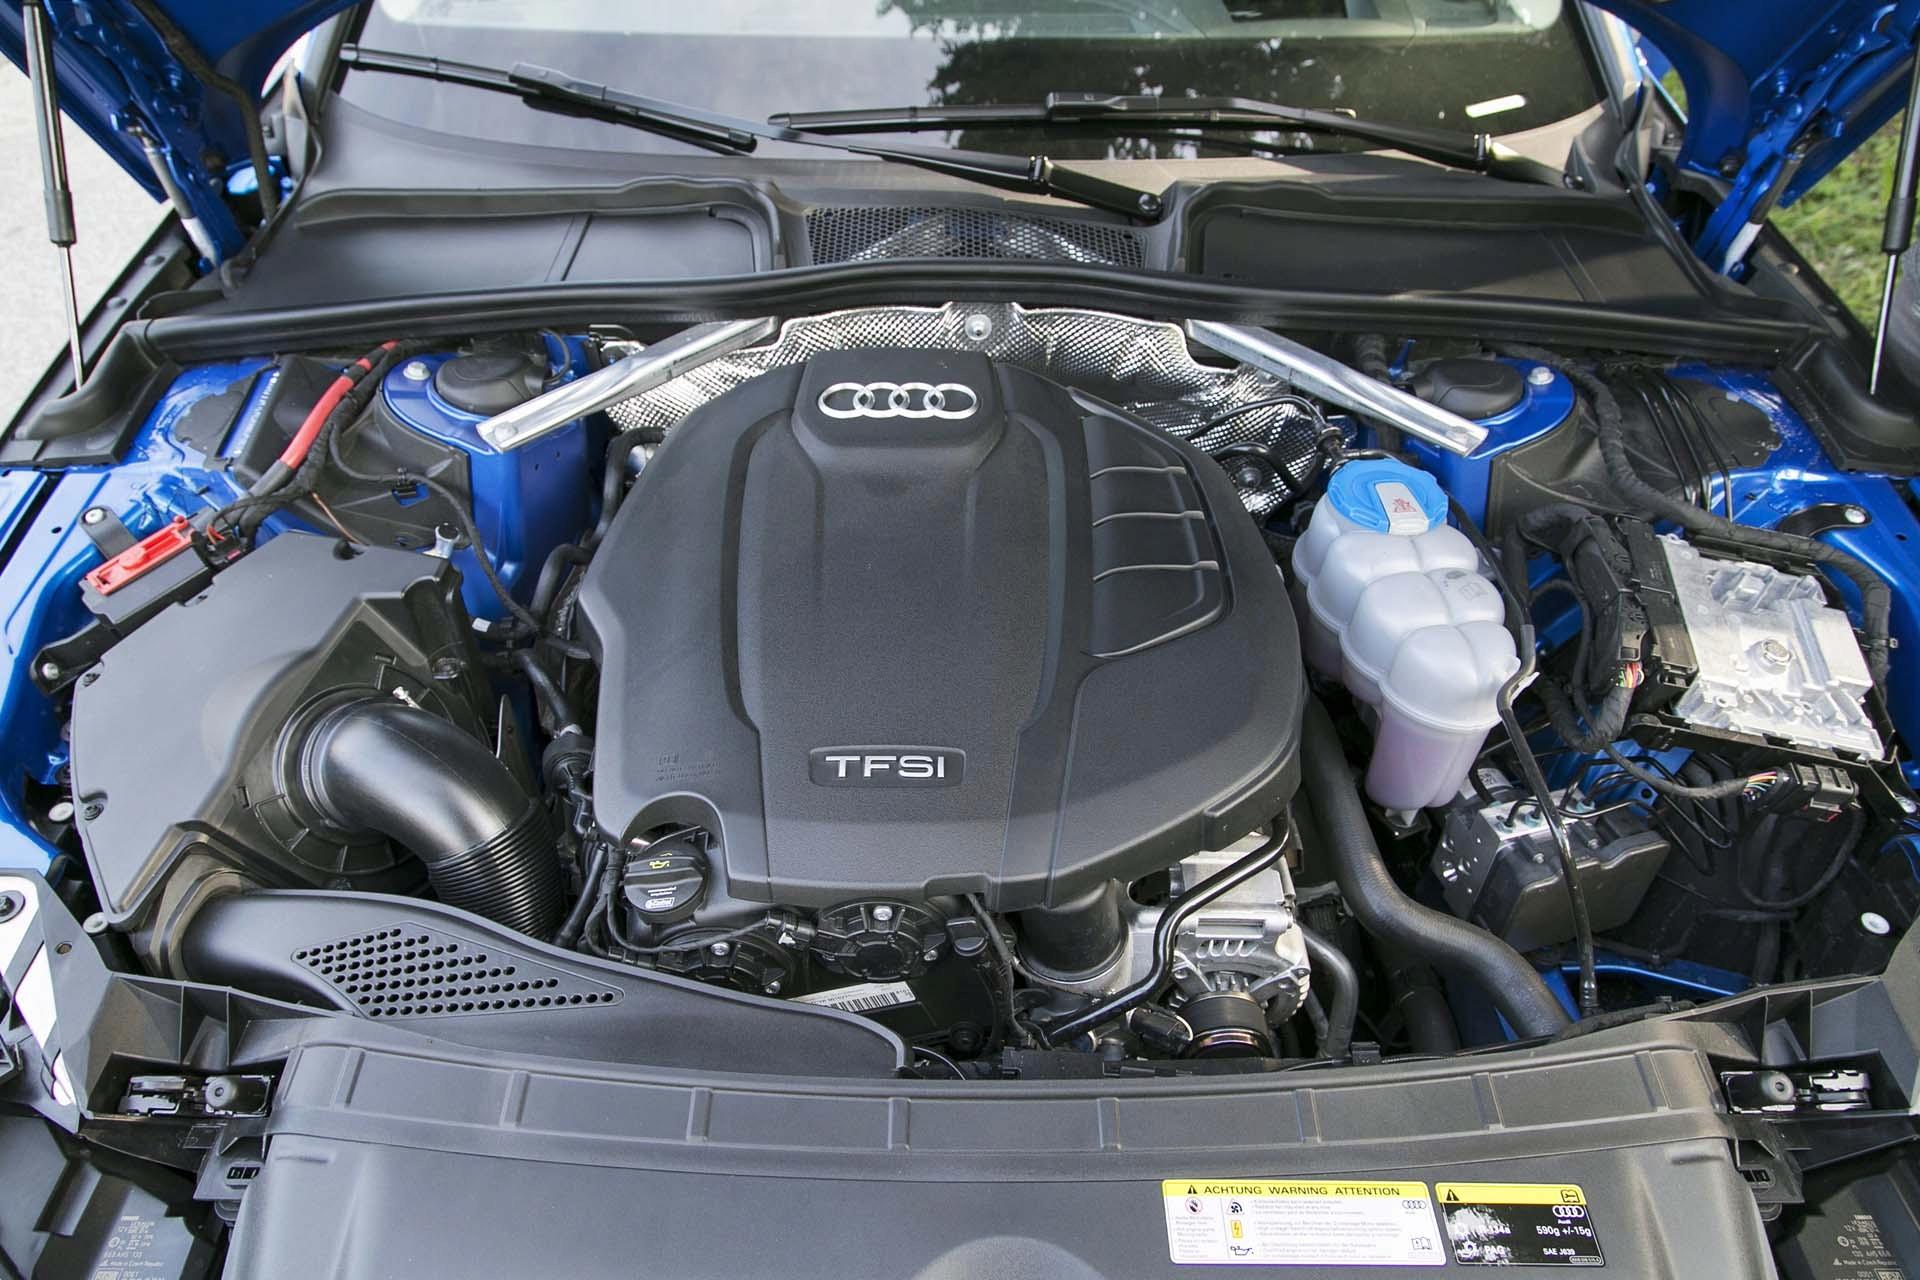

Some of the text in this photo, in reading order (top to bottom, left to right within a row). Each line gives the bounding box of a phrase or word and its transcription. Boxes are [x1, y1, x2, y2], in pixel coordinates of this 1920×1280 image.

[825, 755, 945, 778] TFSI
[1203, 1185, 1400, 1196] ACHTUNG WARNING ATTENTION
[1536, 1225, 1560, 1237] 590g
[1562, 1226, 1592, 1237] +/-15g
[1484, 1245, 1505, 1255] PAG
[1543, 1248, 1557, 1256] SAE
